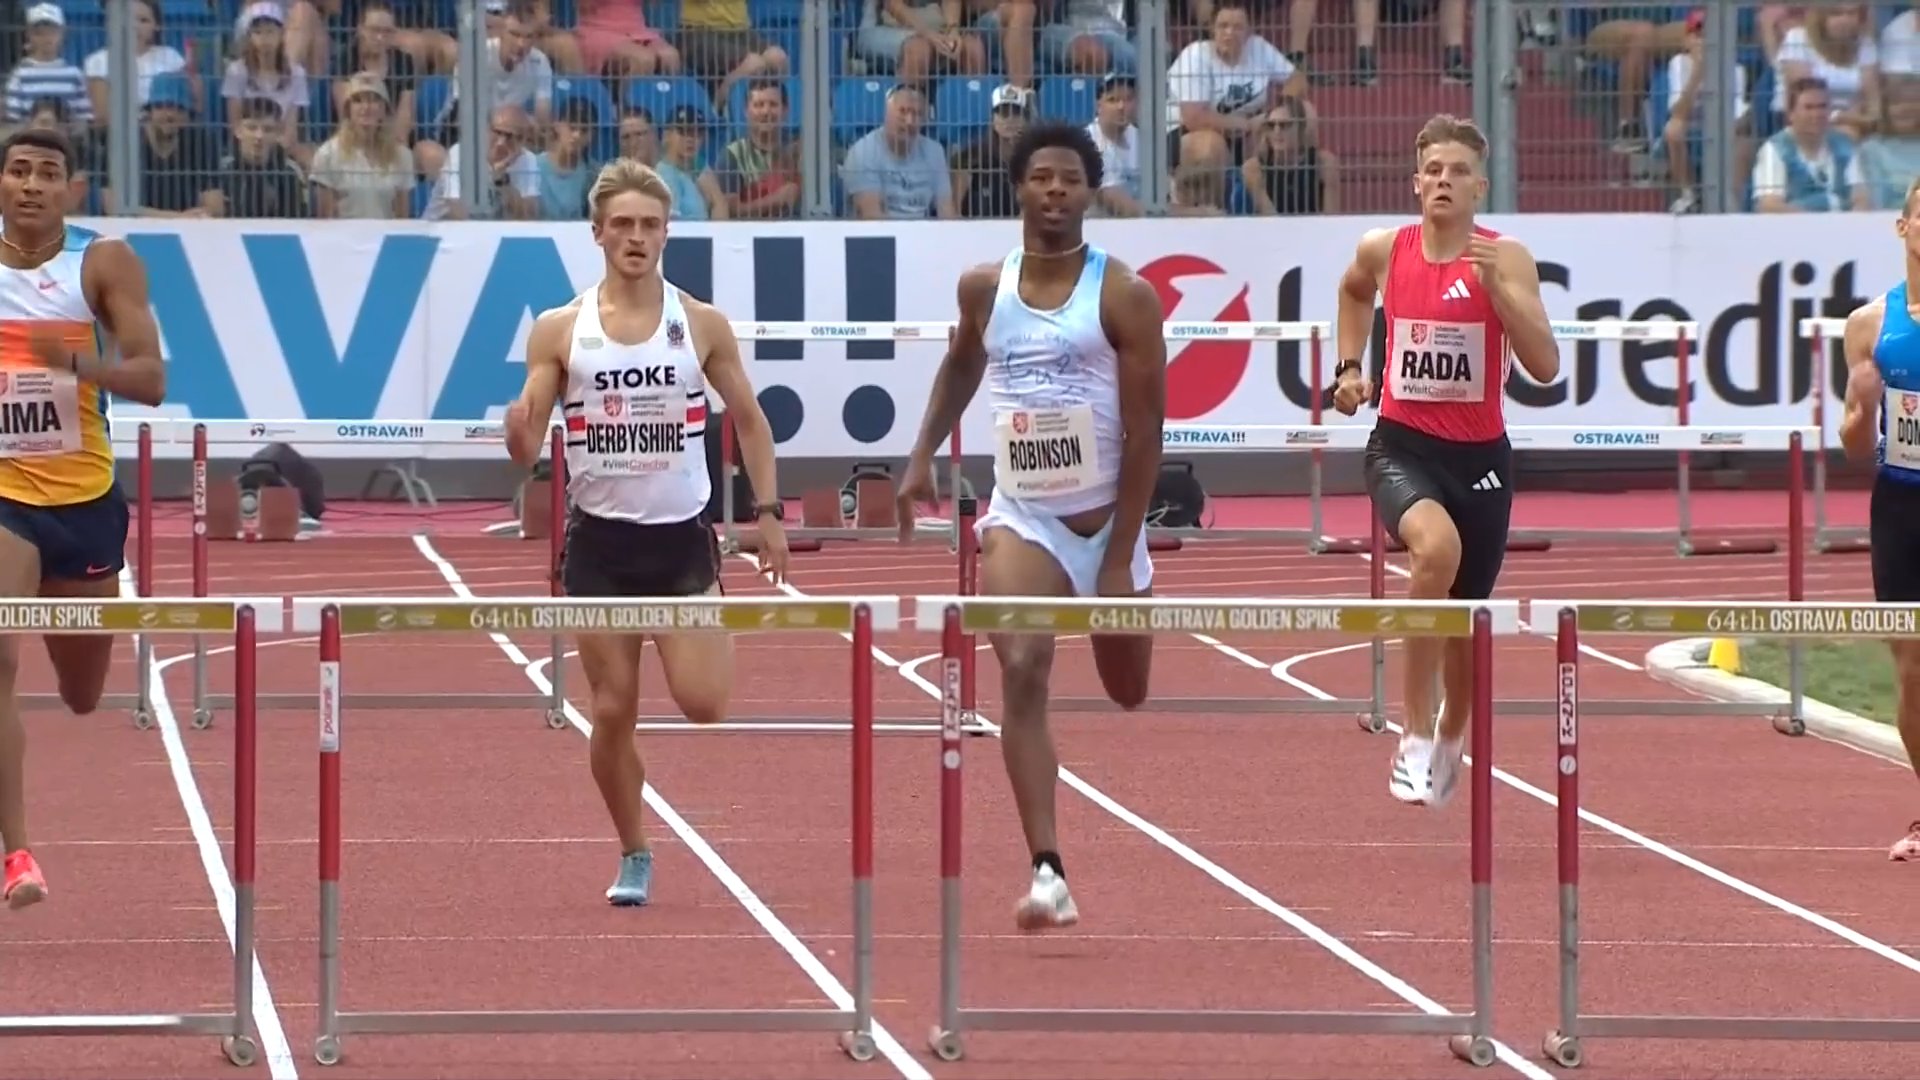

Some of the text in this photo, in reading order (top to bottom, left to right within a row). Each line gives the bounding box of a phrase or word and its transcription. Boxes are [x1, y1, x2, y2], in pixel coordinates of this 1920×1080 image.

[594, 365, 676, 391] STOKE
[1401, 350, 1472, 382] RADA
[0, 401, 62, 434] IMA
[336, 425, 424, 438] OSTRAVA!!!
[586, 422, 685, 454] DERBYSHIRE
[1162, 431, 1246, 443] OSTRAVA!!!
[1573, 432, 1659, 445] OSTRAVA!!!
[1009, 435, 1083, 471] ROBINSON
[55, 605, 103, 628] SPIKE
[469, 605, 724, 629] 64th OSTRAVA GOLDEN SPIKE
[1089, 607, 1147, 629] 64th
[1151, 607, 1226, 630] OSTRAVA
[1229, 607, 1292, 630] GOLDEN
[1295, 607, 1342, 630] SPIKE
[1706, 608, 1916, 632] 64th OSTRAVA GOLDEN
